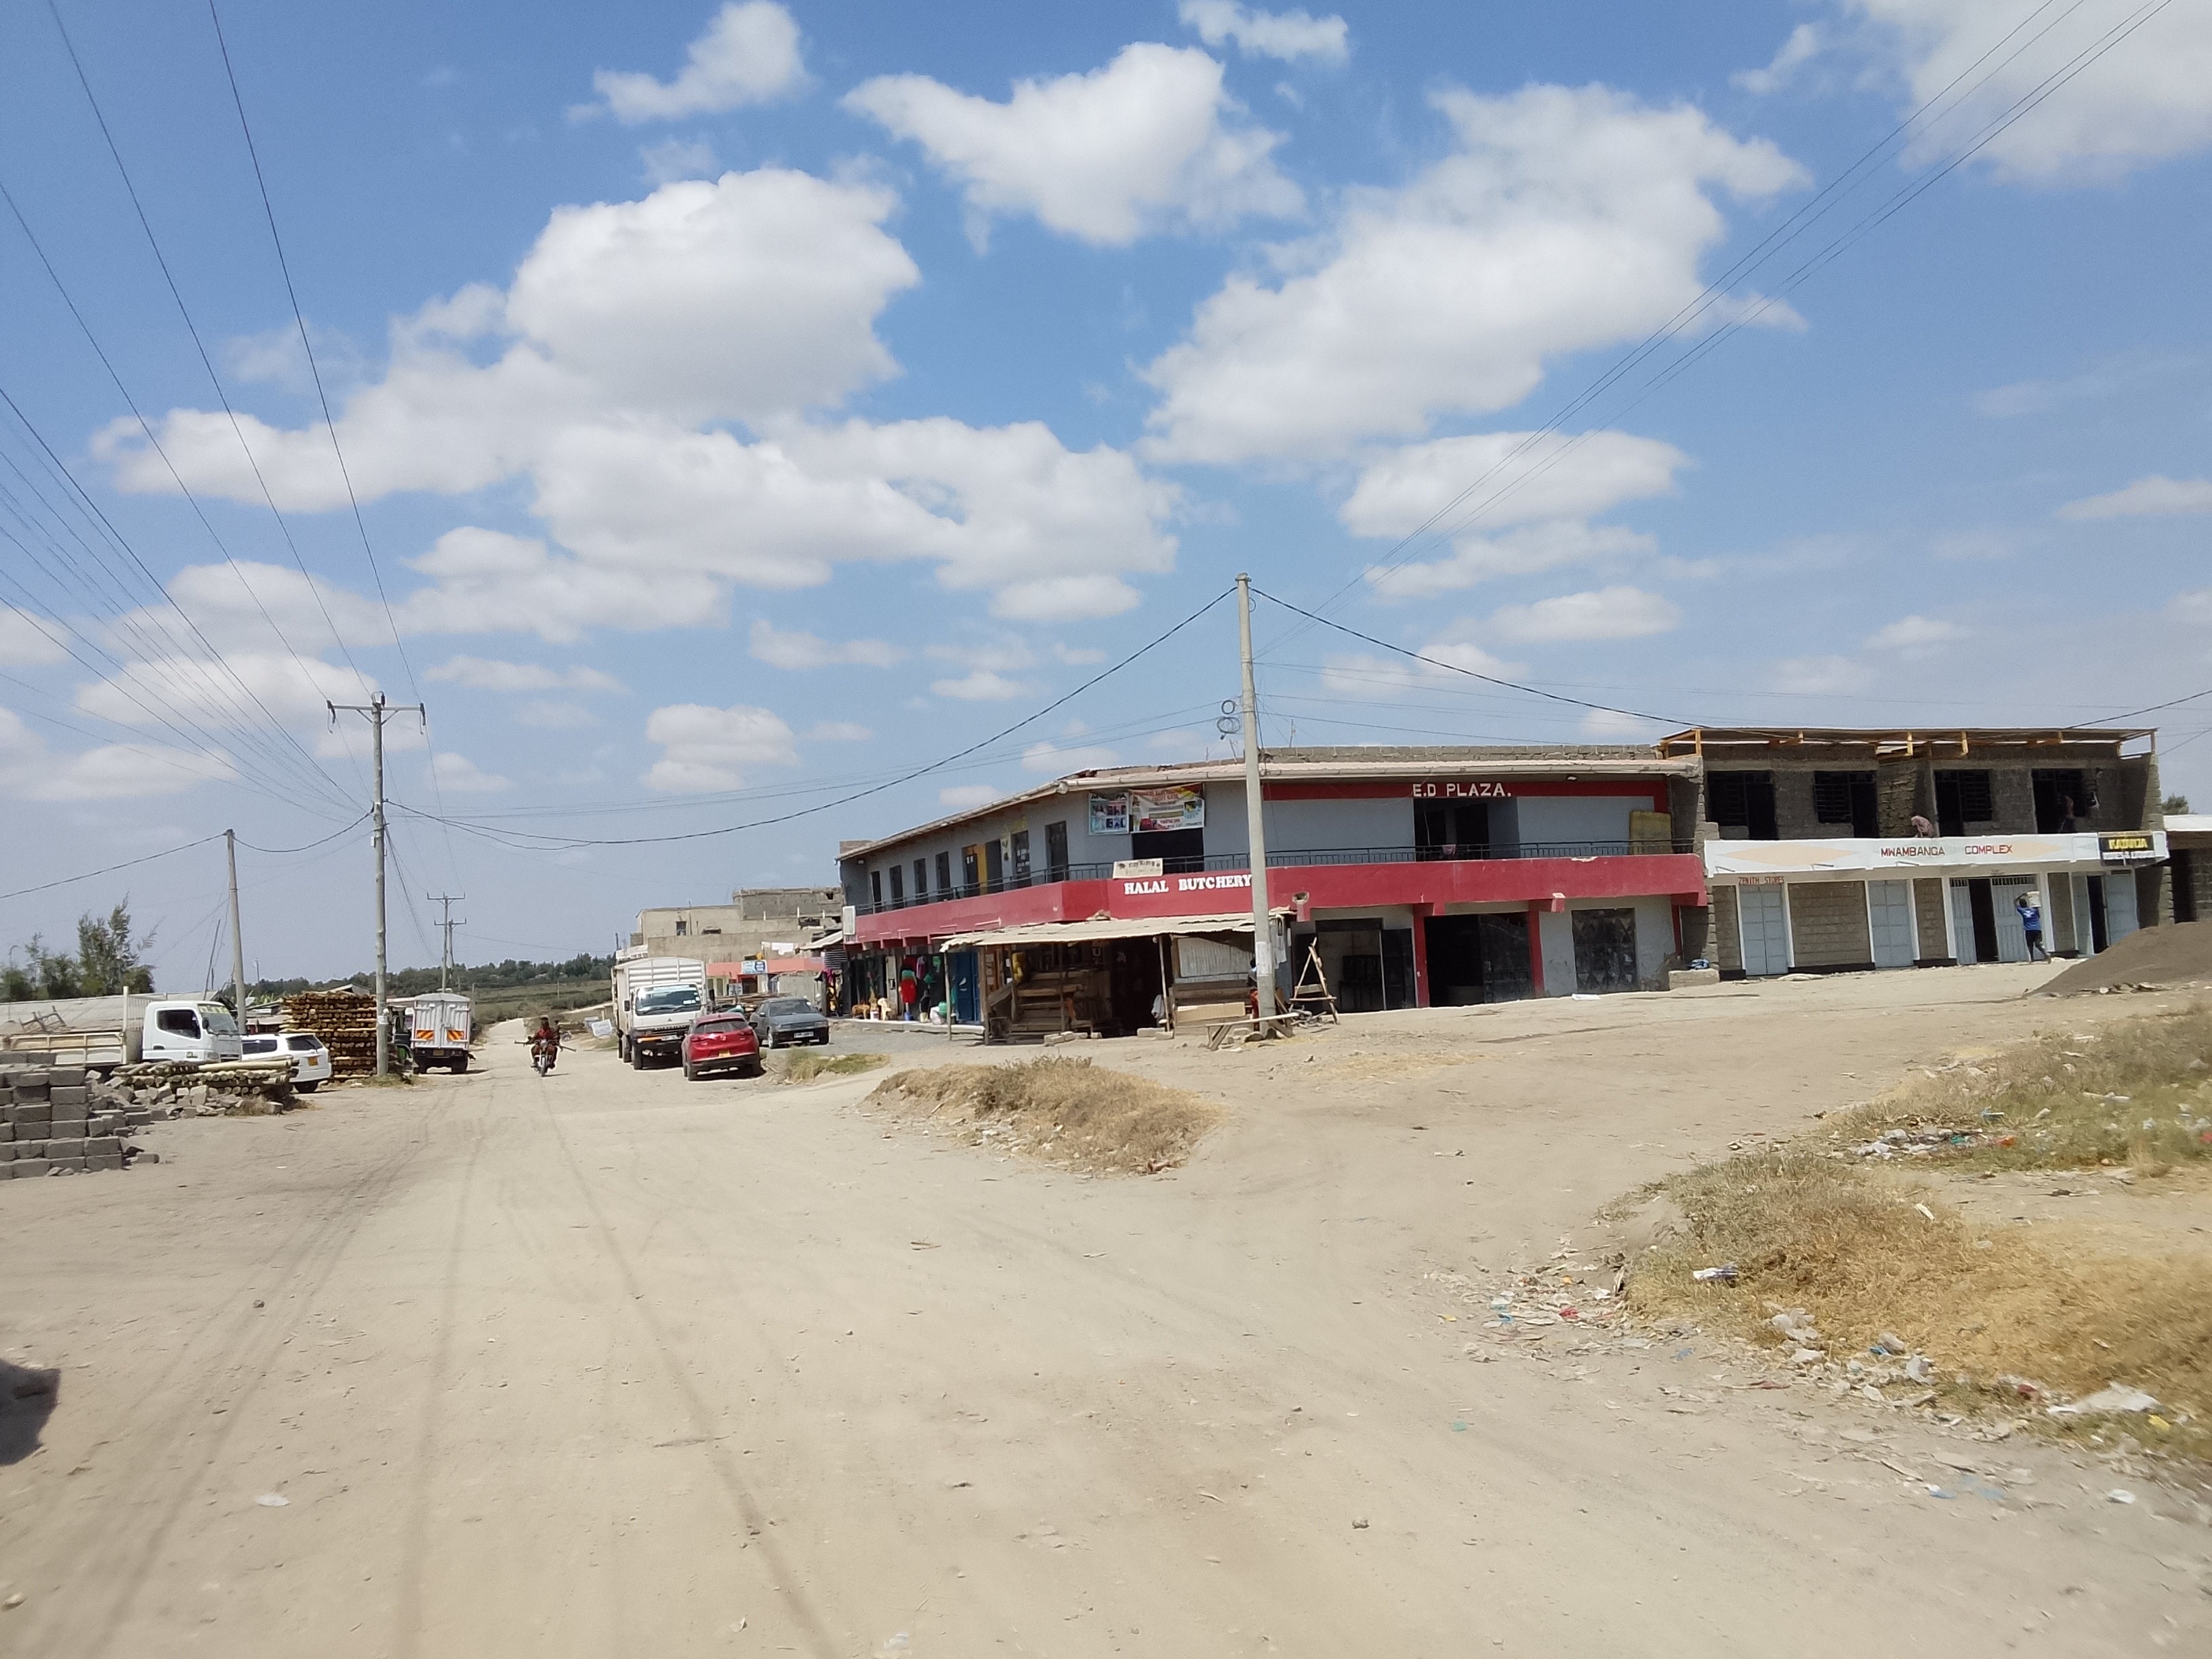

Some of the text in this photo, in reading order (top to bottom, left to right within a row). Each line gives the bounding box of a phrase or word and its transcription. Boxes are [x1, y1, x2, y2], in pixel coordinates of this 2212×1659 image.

[1412, 782, 1512, 797] E.D PLAZA.
[1881, 844, 2013, 857] MWAMBANGA COMPLEX
[1124, 874, 1252, 895] HALAL BUTCHERY
